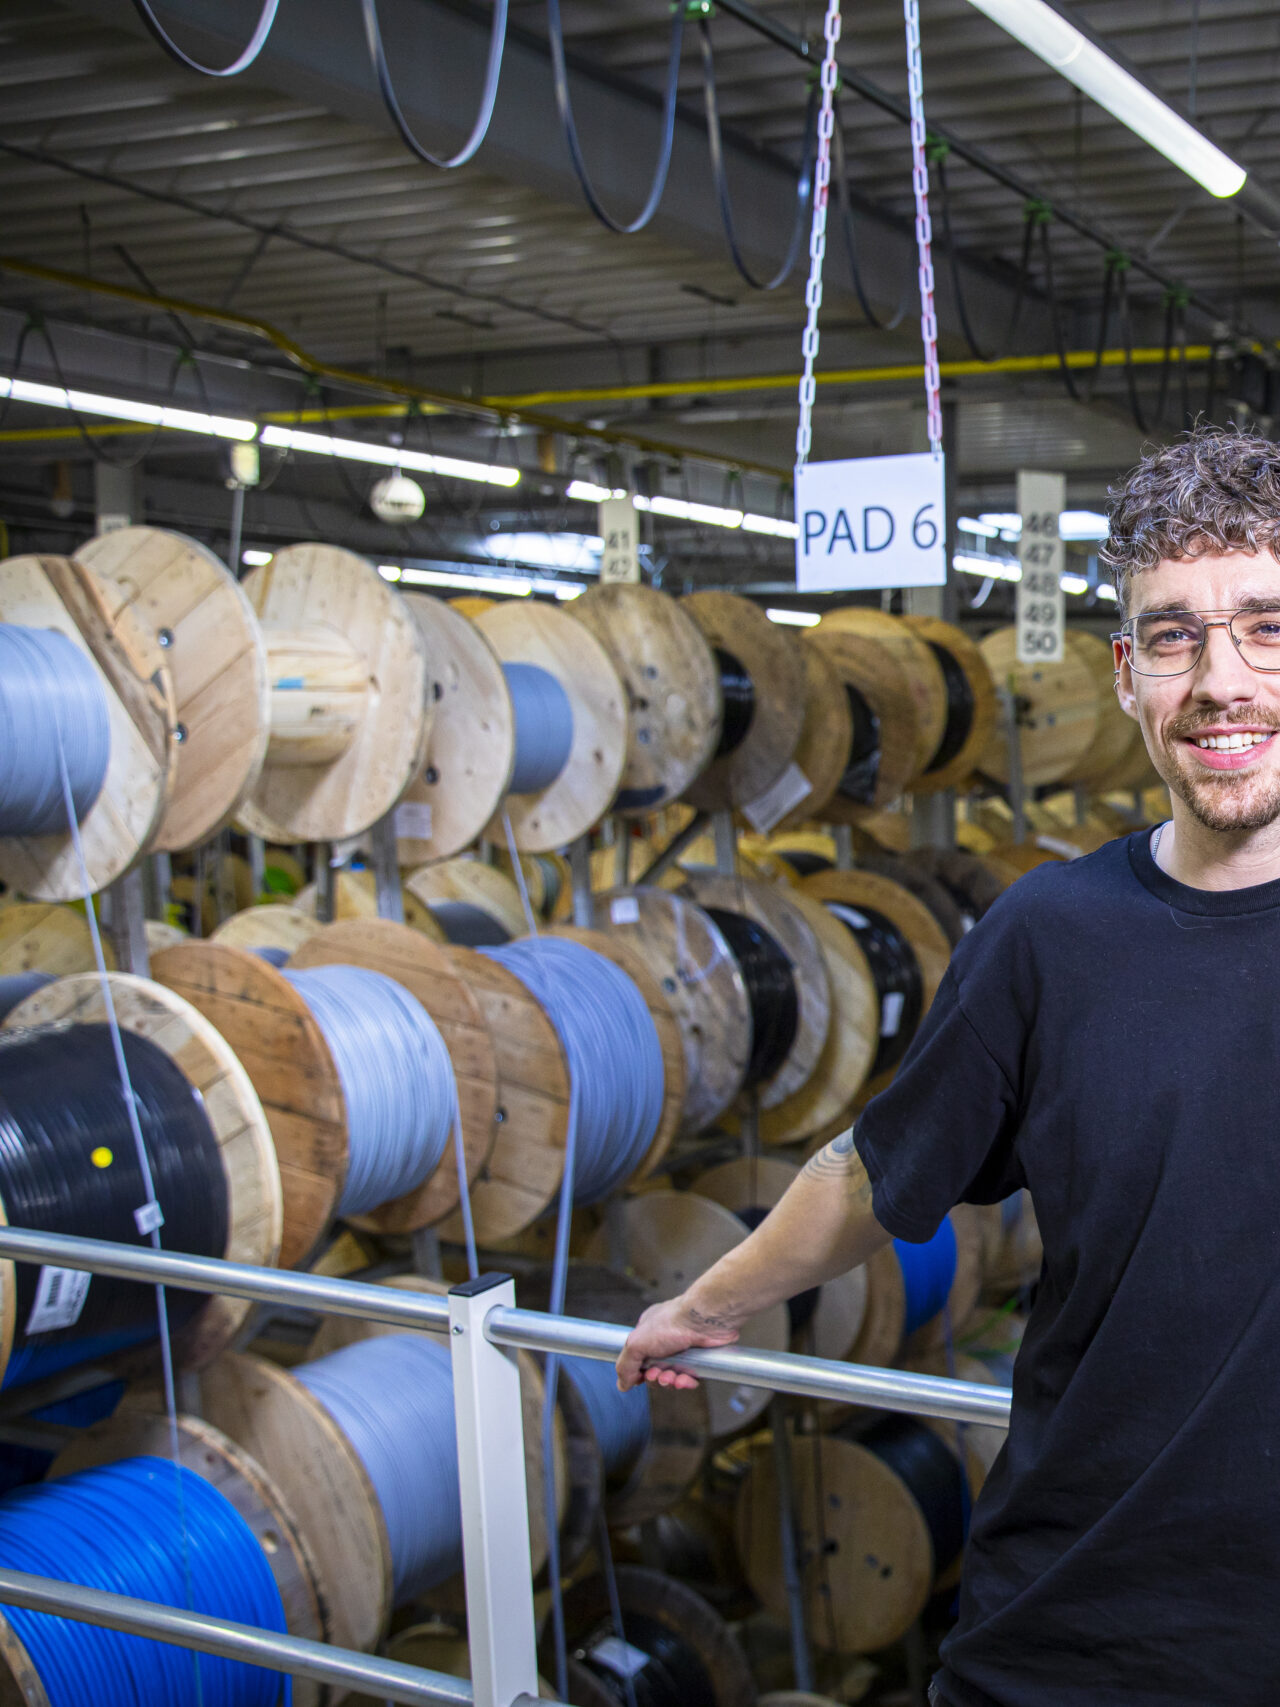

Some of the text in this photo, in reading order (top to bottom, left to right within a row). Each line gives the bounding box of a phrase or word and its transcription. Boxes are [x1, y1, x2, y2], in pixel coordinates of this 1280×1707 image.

[804, 503, 938, 556] PAD 6
[1025, 512, 1058, 538] 46
[1024, 543, 1056, 566] 47
[1024, 571, 1057, 597] 48
[1024, 602, 1057, 627] 49
[1023, 629, 1058, 655] 50
